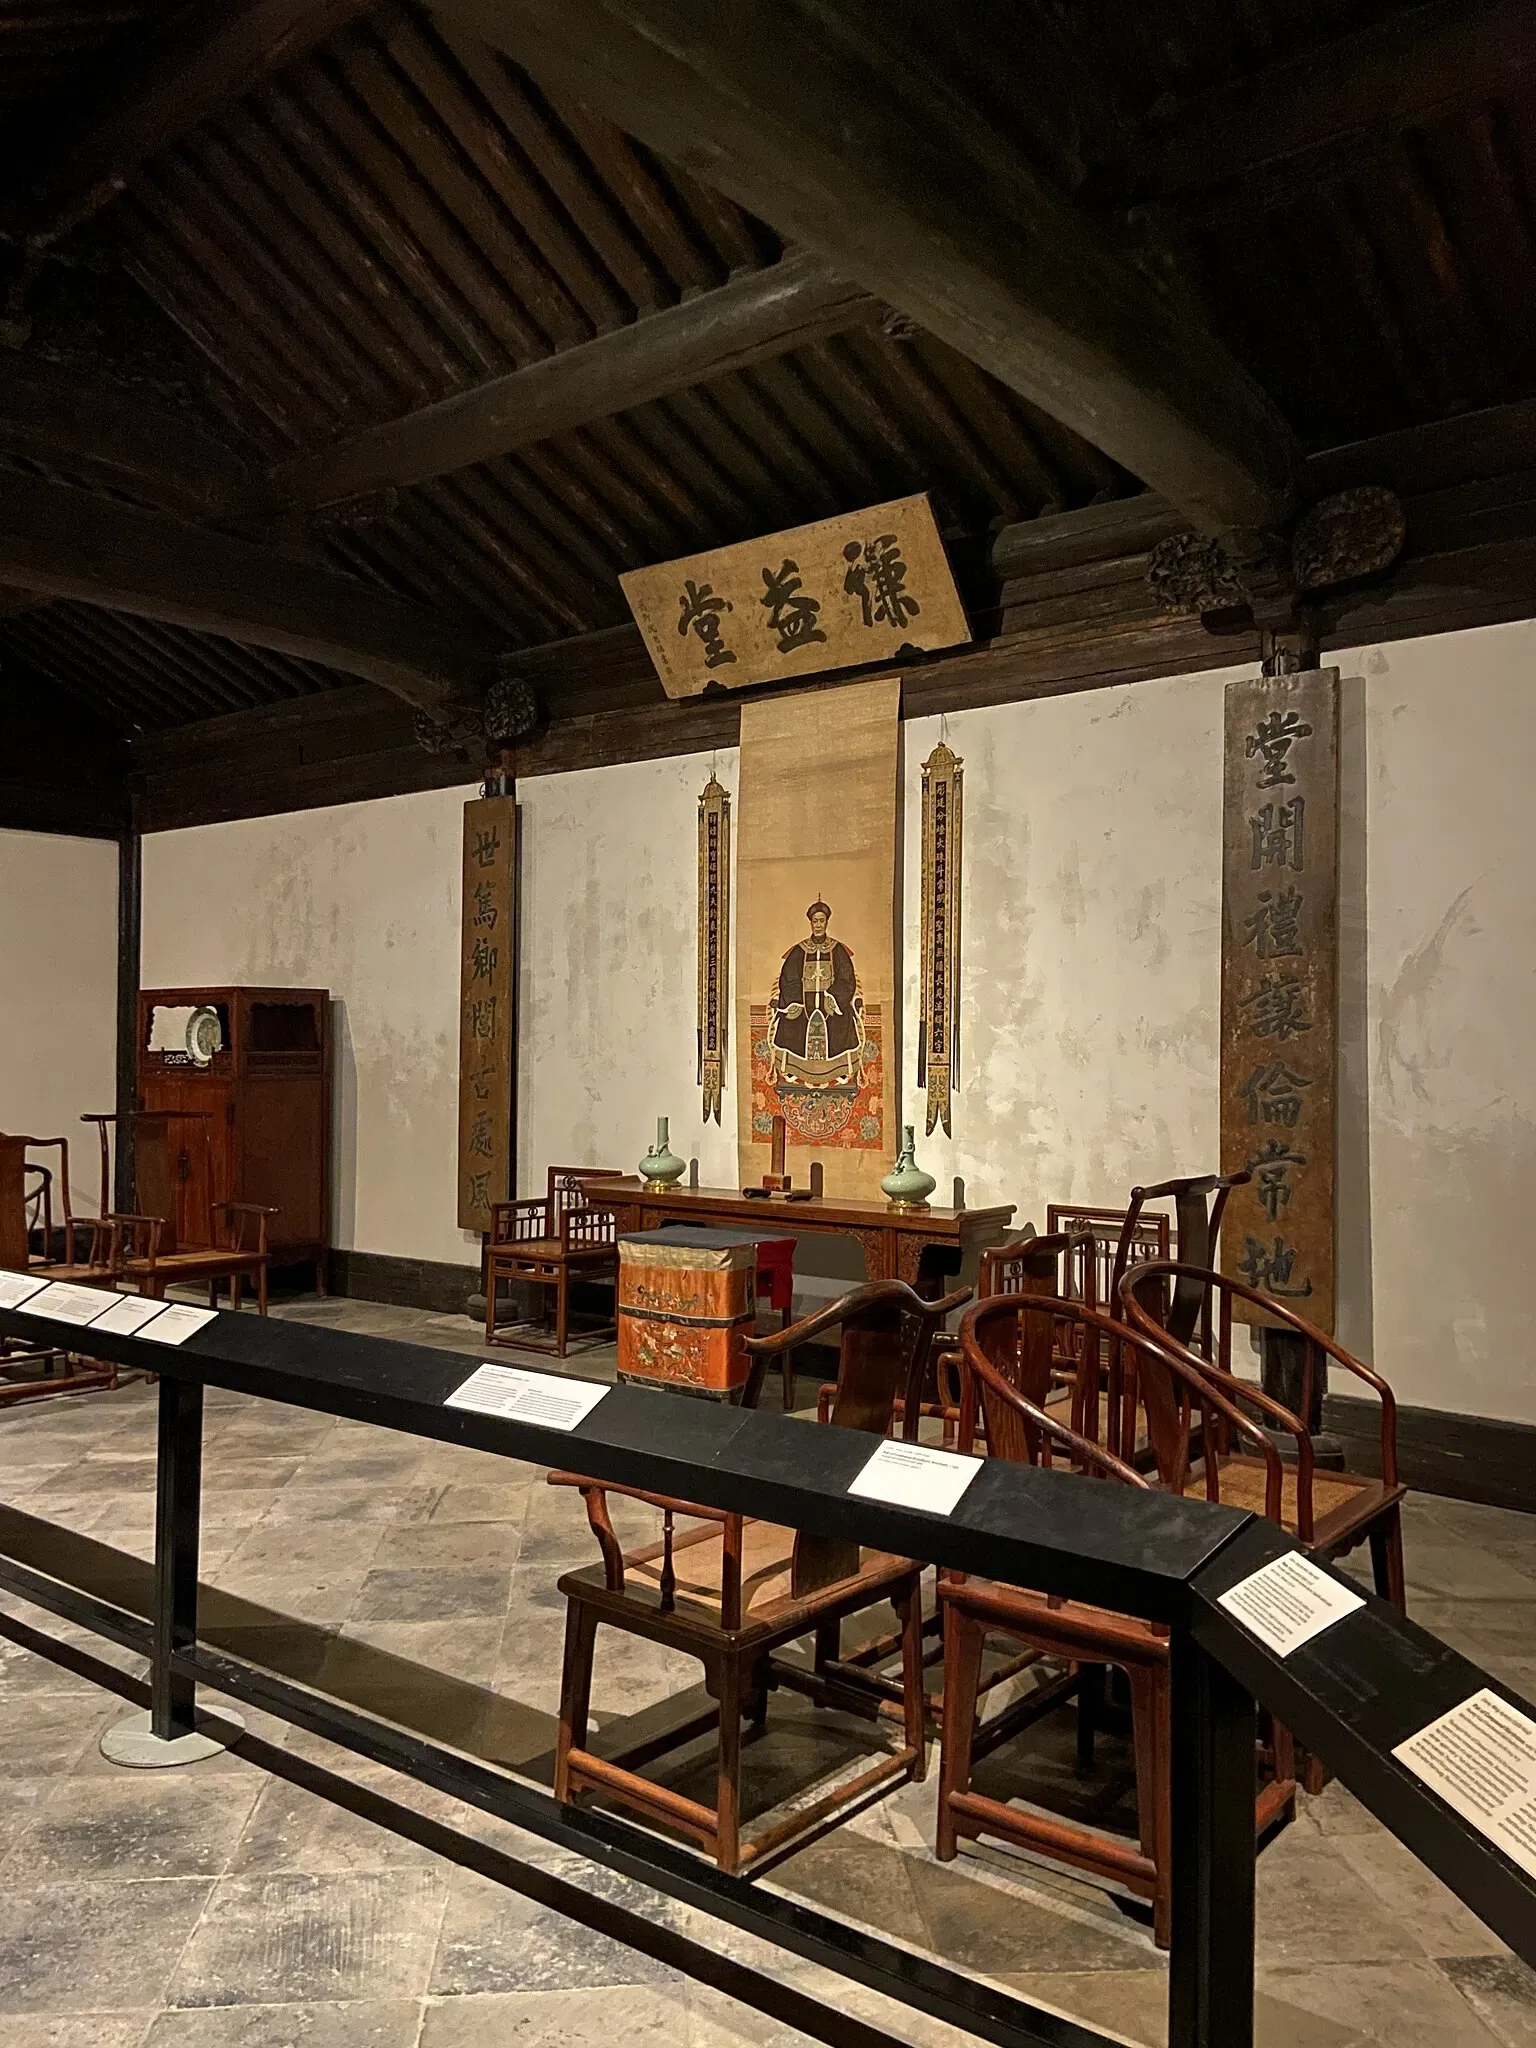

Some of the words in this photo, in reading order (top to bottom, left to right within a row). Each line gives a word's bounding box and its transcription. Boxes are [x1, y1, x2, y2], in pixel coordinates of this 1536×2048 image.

[1236, 710, 1314, 1298] 堂開禮讓倫常地
